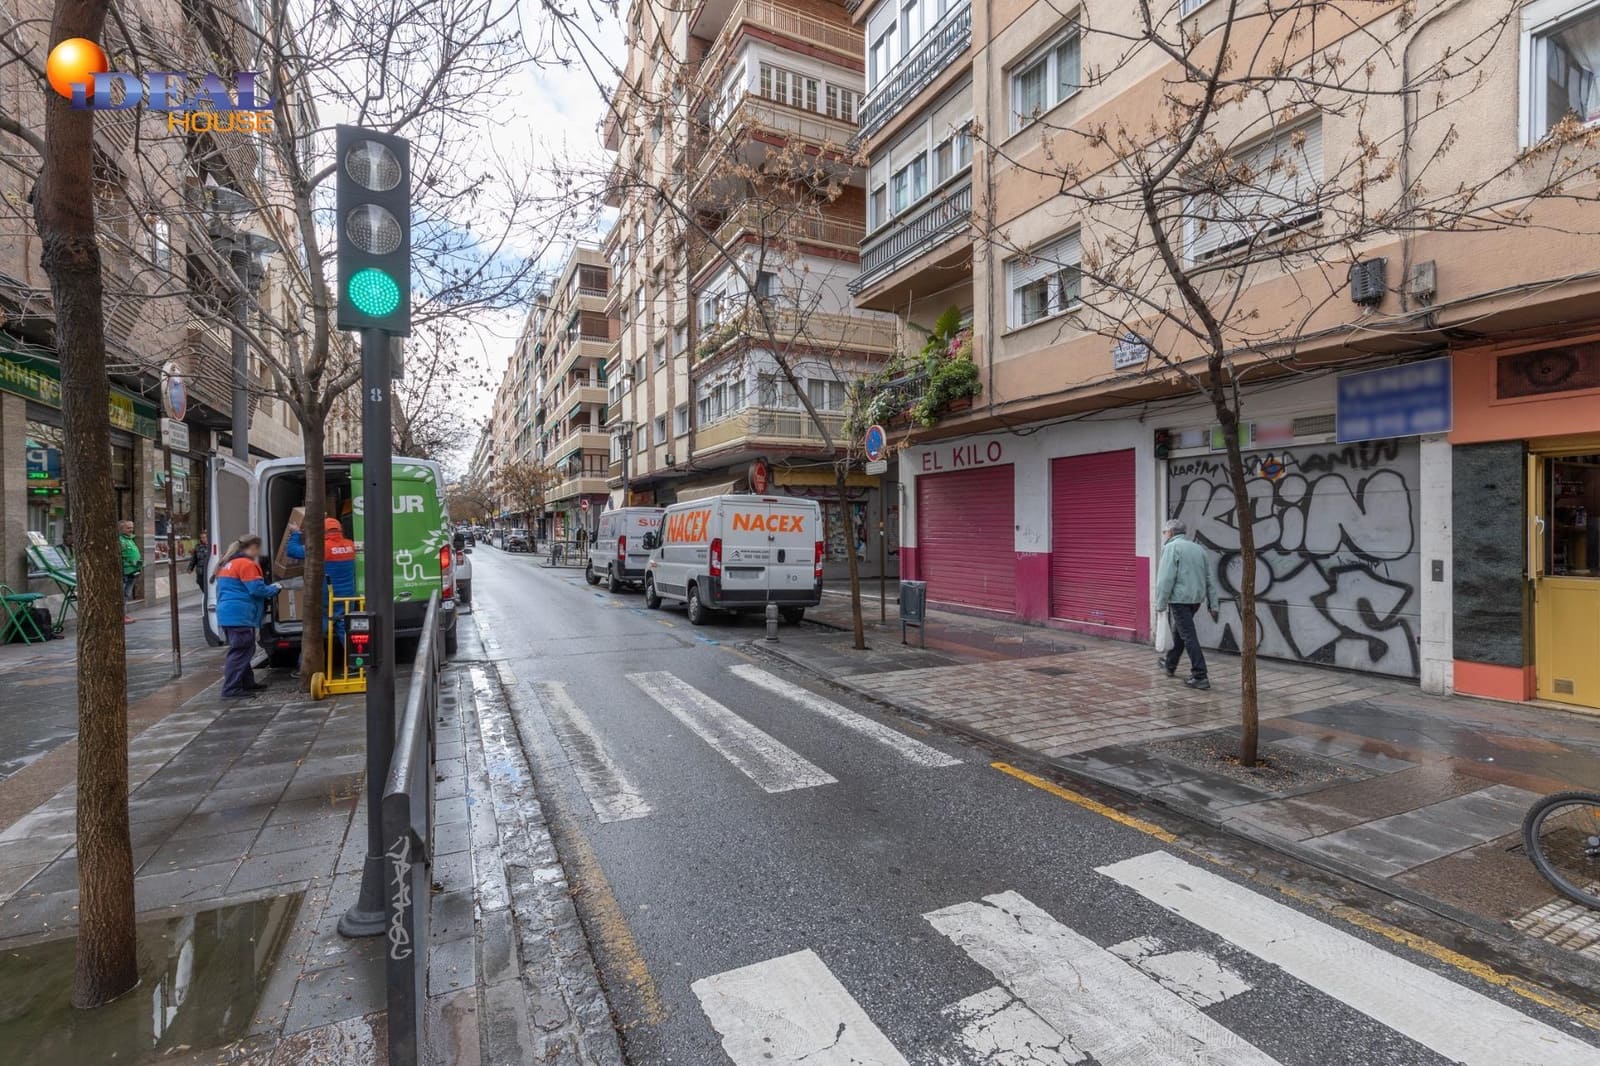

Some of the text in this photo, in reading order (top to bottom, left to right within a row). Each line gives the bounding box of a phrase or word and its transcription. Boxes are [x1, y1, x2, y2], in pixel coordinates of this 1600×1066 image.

[922, 441, 1002, 471] EL KILO
[353, 495, 425, 515] SUR
[667, 509, 712, 543] NACEX
[731, 512, 805, 533] NACEX
